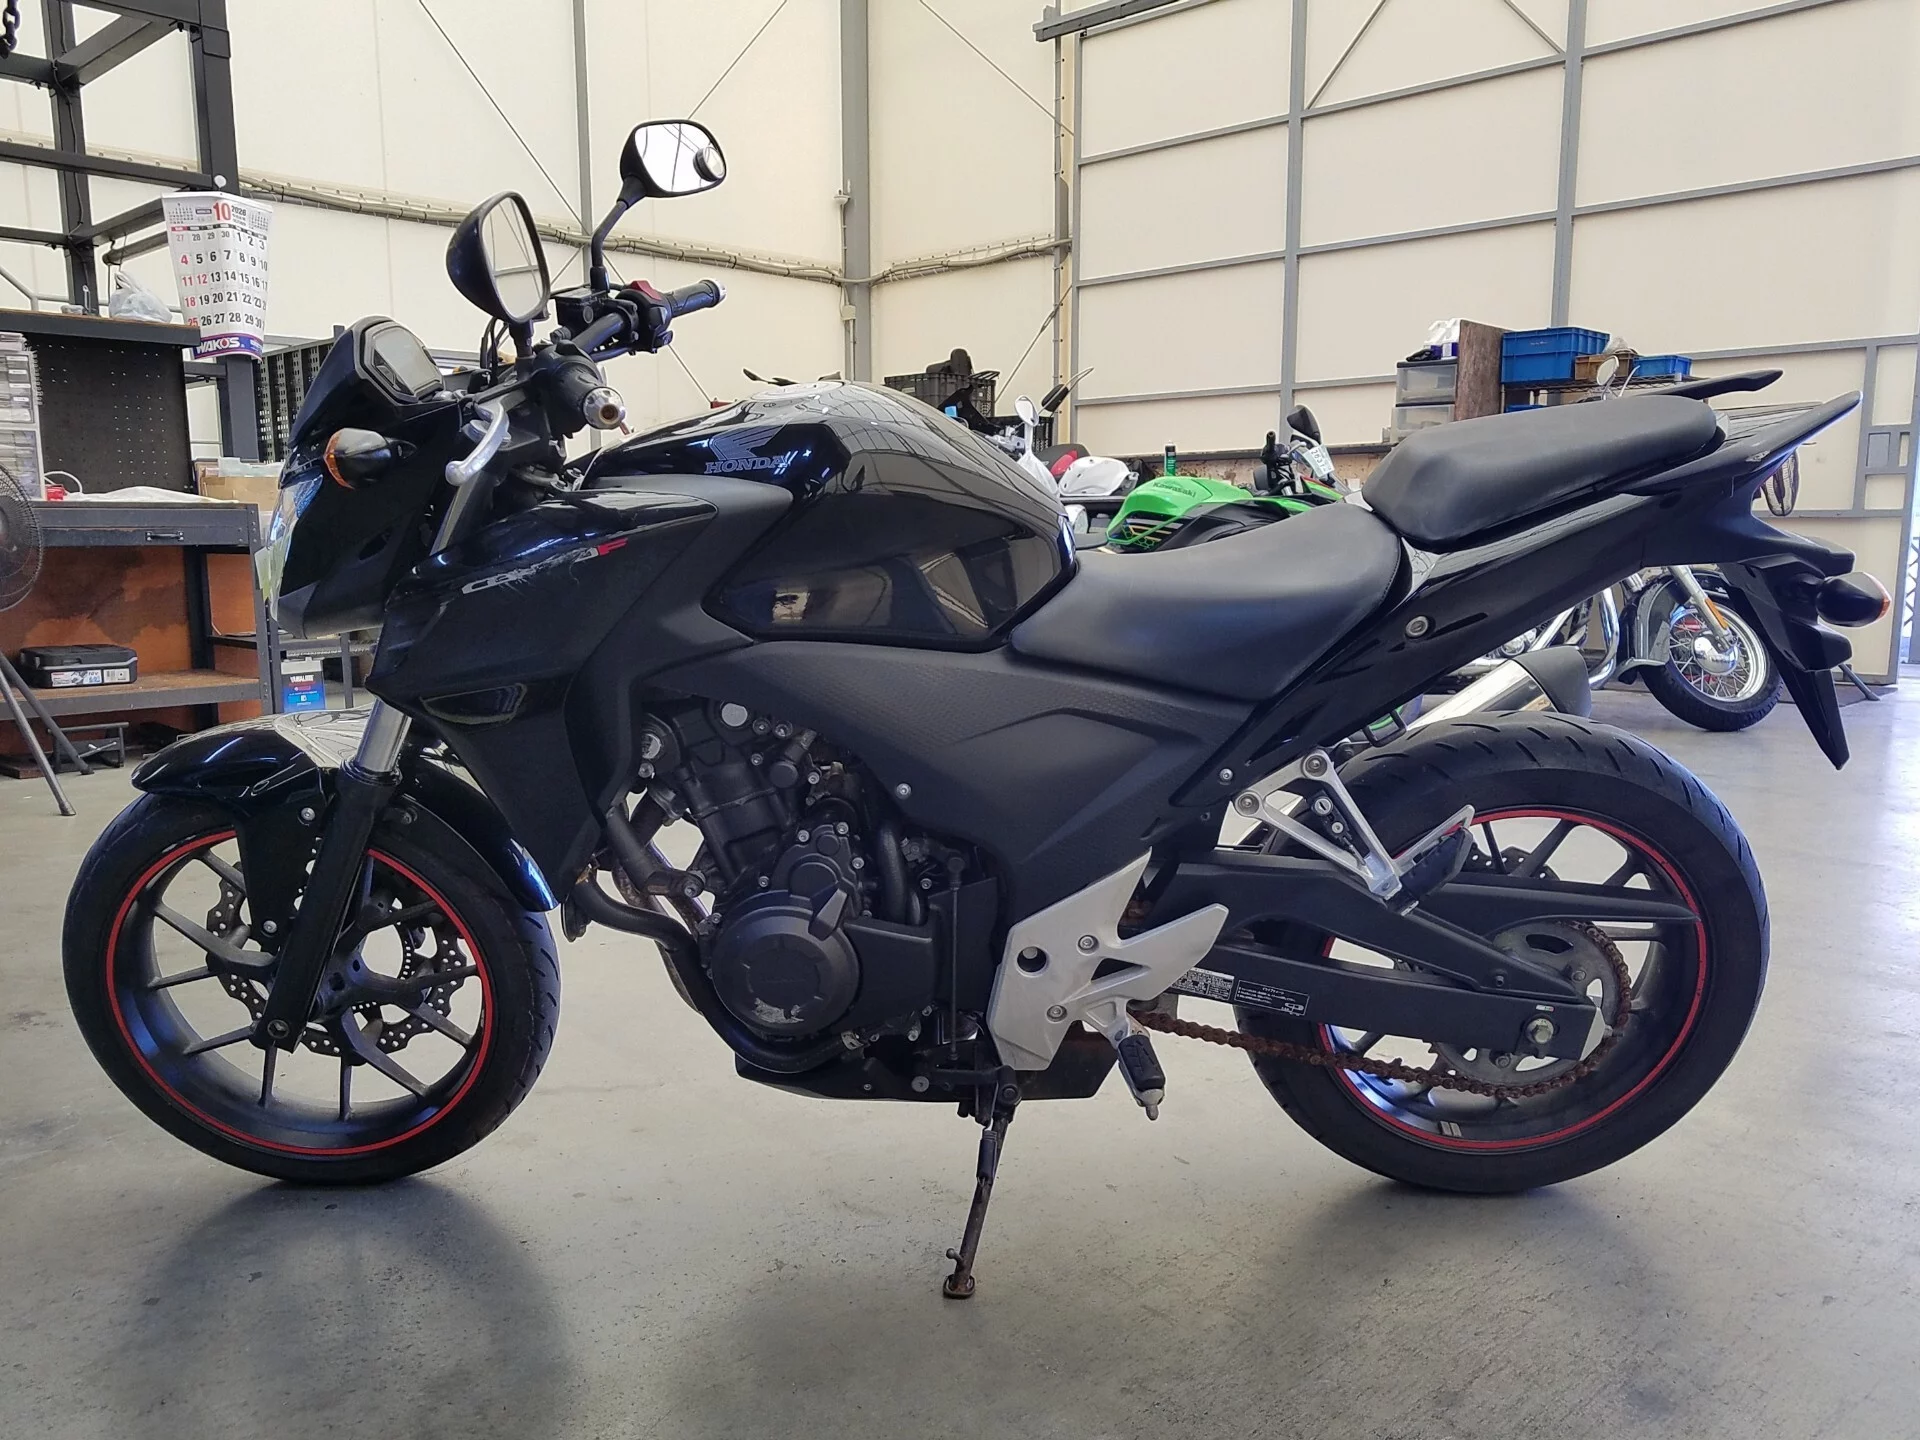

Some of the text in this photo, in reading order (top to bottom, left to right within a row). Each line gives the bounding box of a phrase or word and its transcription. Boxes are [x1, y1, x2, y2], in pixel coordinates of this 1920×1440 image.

[213, 202, 231, 220] 10
[238, 232, 242, 241] 1
[248, 236, 254, 246] 2
[260, 240, 264, 250] 3
[181, 250, 267, 271] 4 5 6 7 8 9 10
[183, 276, 192, 286] 11
[197, 274, 207, 284] 12
[211, 272, 220, 282] 13
[224, 271, 236, 281] 14
[240, 273, 249, 284] 15
[252, 277, 260, 287] 16
[185, 297, 196, 307] 18
[199, 295, 210, 305] 19
[212, 293, 223, 303] 20
[227, 292, 238, 301] 21
[242, 293, 252, 304] 22
[254, 297, 262, 308] 23
[188, 318, 198, 326] 25
[201, 316, 212, 326] 26
[214, 313, 225, 324] 27
[229, 312, 241, 322] 28
[244, 314, 254, 325] 29
[704, 455, 788, 475] HONDA
[1153, 482, 1196, 498] Kawasaki
